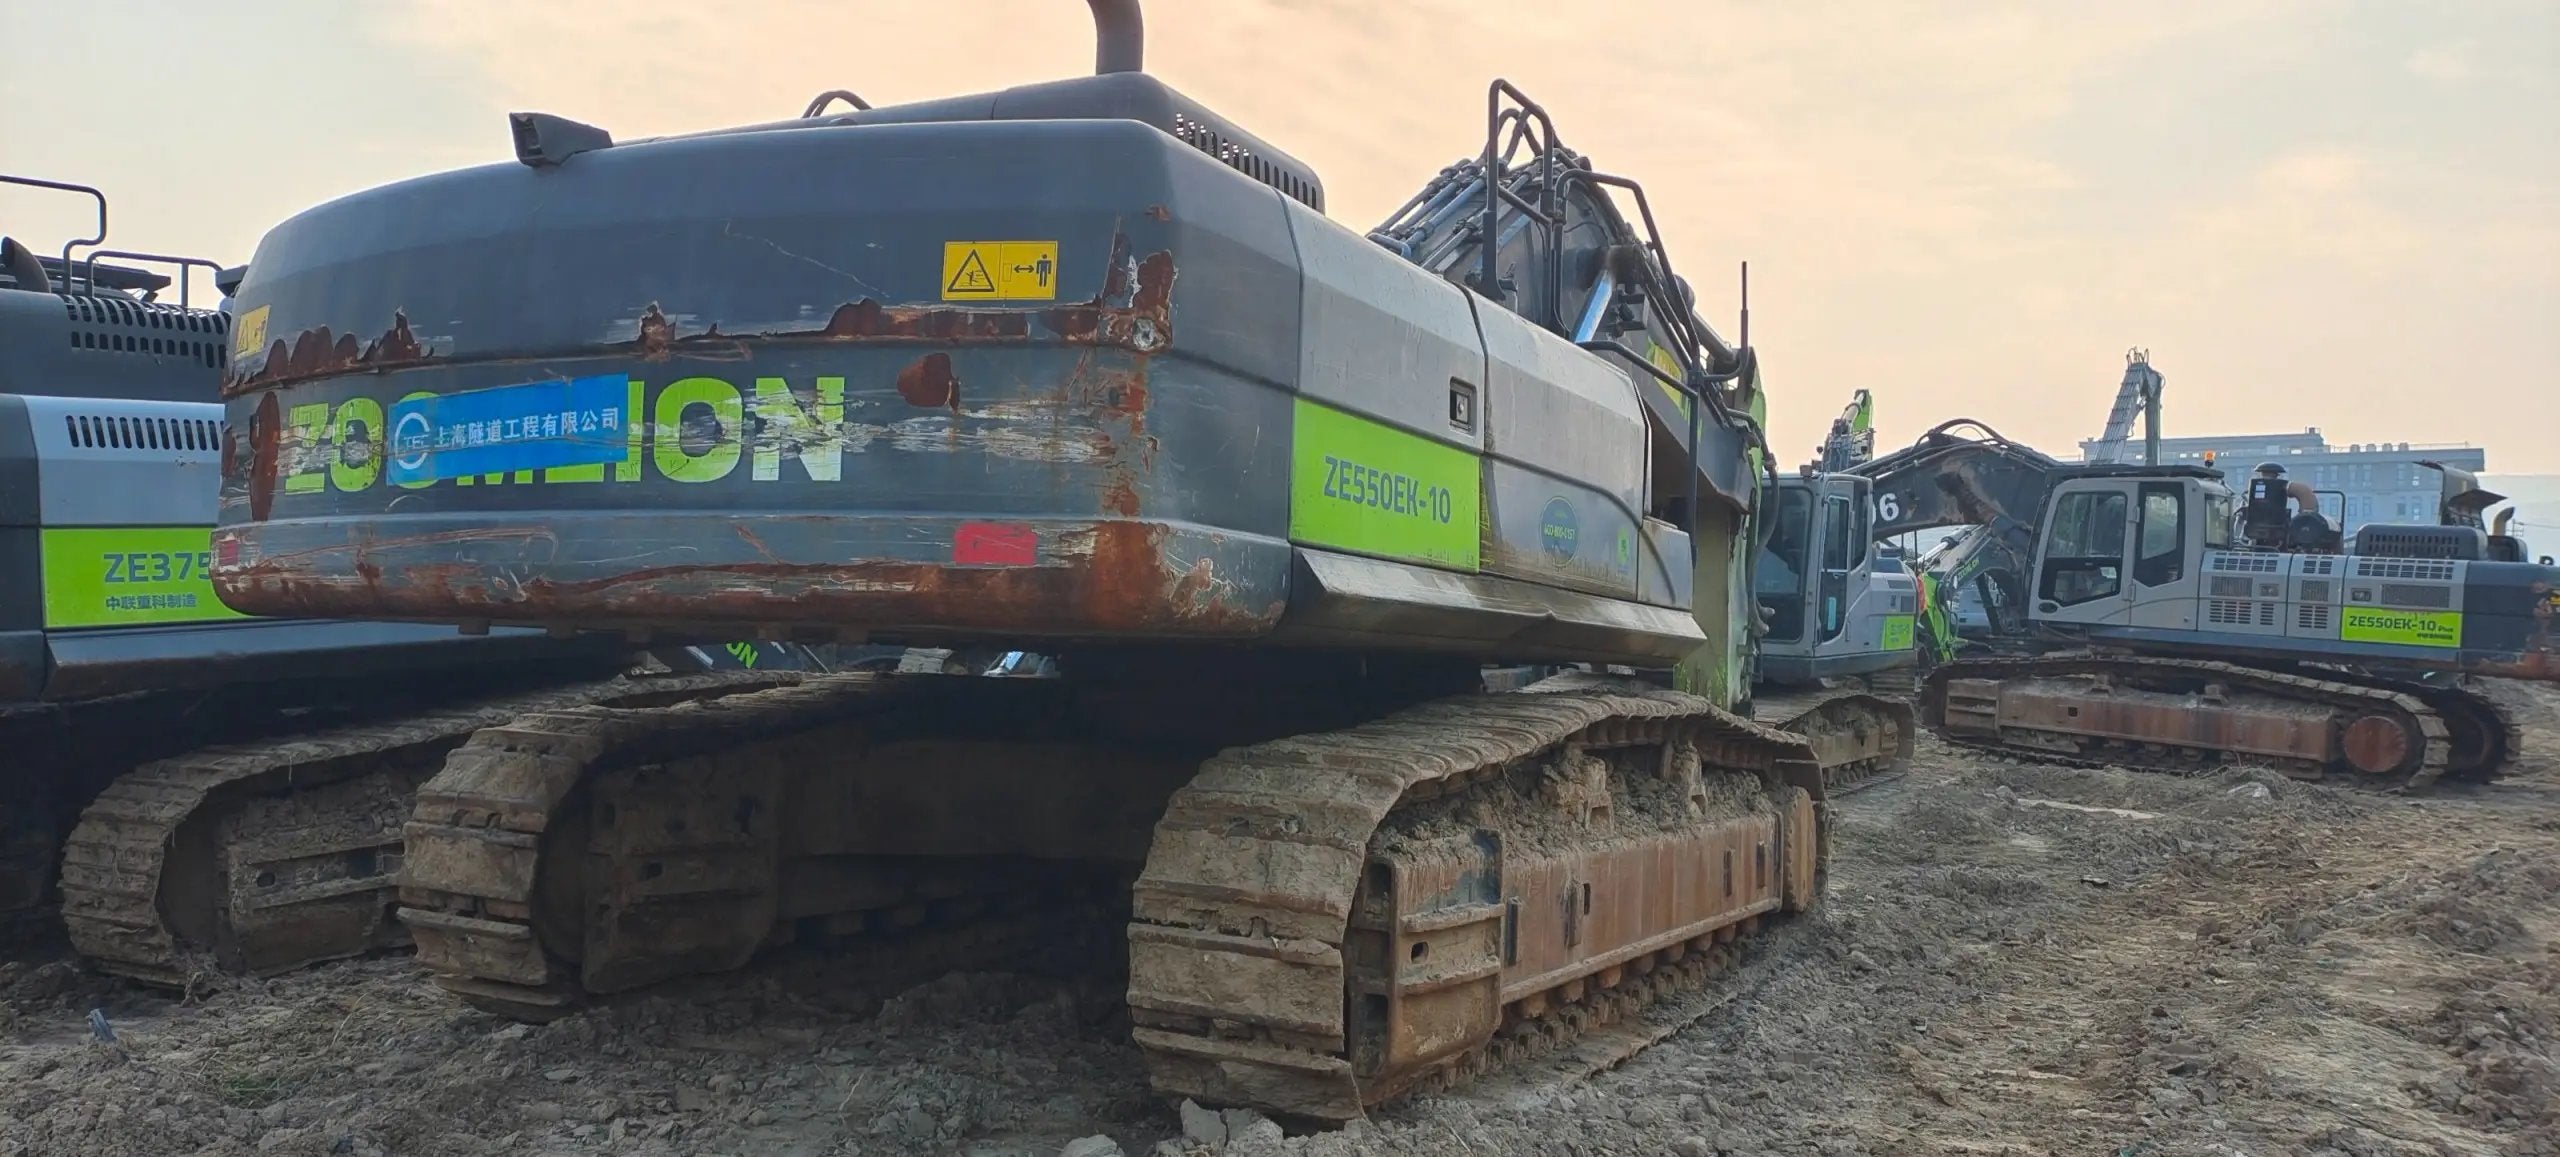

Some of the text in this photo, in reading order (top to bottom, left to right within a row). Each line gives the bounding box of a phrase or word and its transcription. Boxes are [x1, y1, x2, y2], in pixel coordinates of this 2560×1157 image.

[285, 377, 845, 495] ZOION
[434, 407, 619, 449] 上海隧道工程有限公司
[1324, 456, 1452, 524] ZE550EK-10
[1872, 493, 1900, 522] 6
[105, 592, 197, 611] 中联重科制造
[2349, 615, 2437, 632] ZE550EK-10
